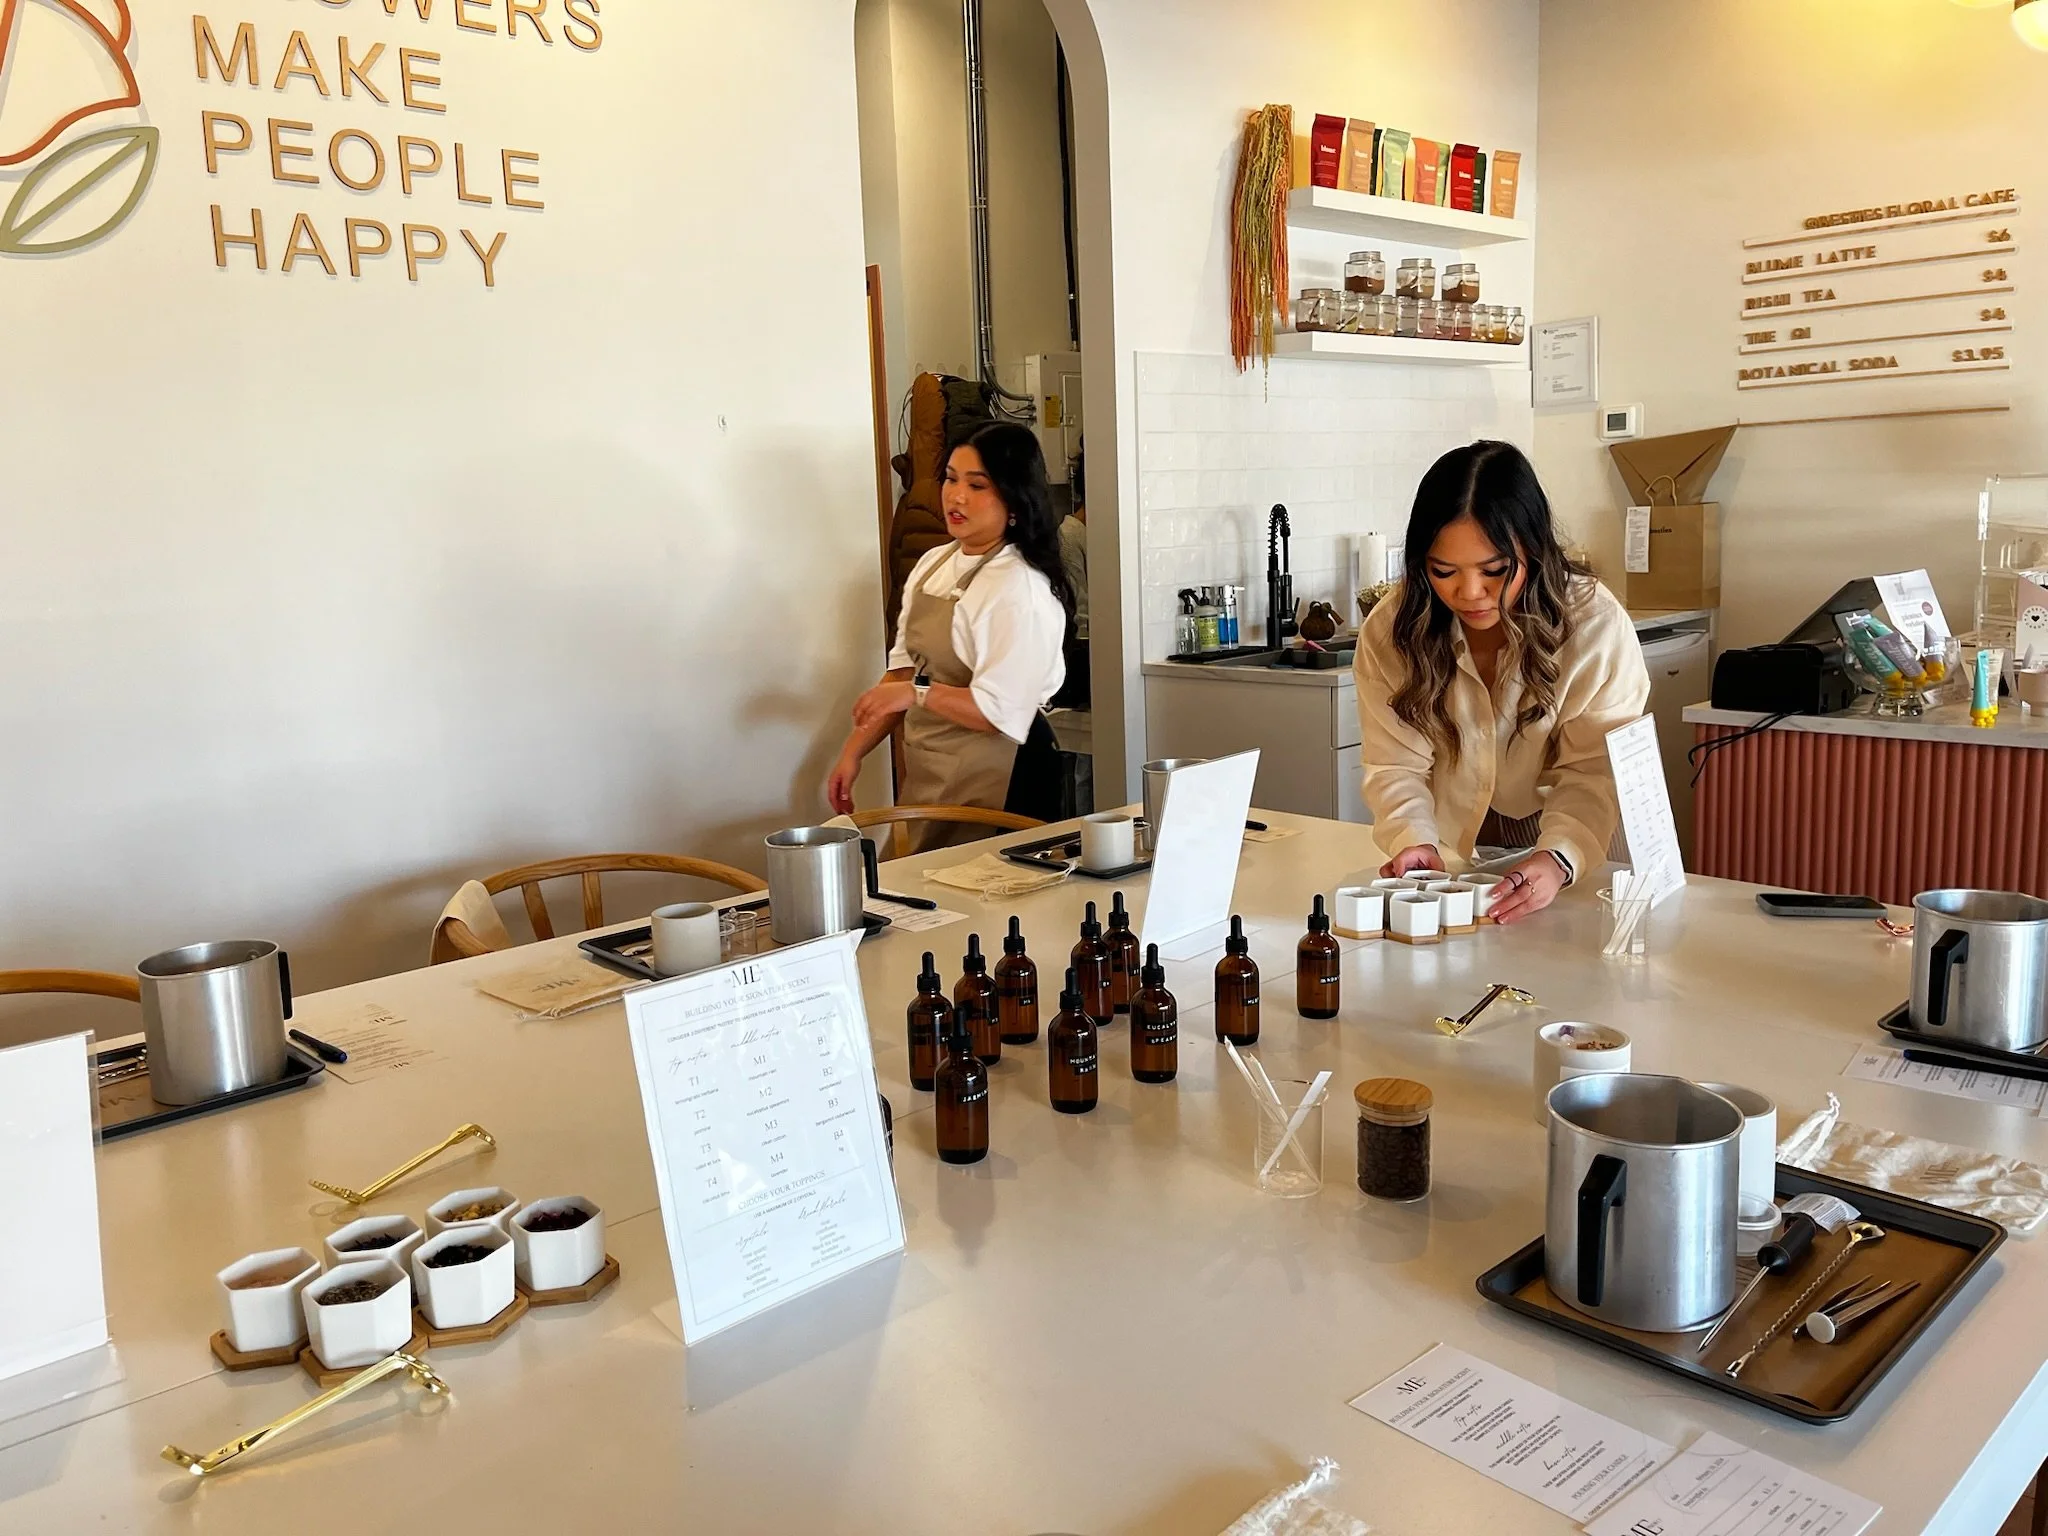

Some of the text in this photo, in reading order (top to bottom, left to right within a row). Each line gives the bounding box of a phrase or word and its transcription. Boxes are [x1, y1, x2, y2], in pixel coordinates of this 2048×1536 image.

[310, 0, 603, 51] ERS
[192, 14, 447, 113] MAKE
[202, 110, 545, 210] PEOPLE
[1886, 196, 1961, 218] FLORAL
[1964, 188, 2016, 208] CAFE
[1986, 228, 2011, 243] $6
[210, 204, 507, 288] HAPPY
[1745, 245, 1878, 275] BLUME LATTE
[1744, 288, 1837, 310] RISHI TEA
[1744, 330, 1777, 345] THE
[1738, 355, 1899, 381] BOTANICAL SODA
[685, 1001, 722, 1018] BUILDING
[745, 986, 787, 1003] SIGNATURE
[787, 976, 811, 990] SCENT
[753, 1054, 767, 1067] M1
[822, 1067, 834, 1077] B2
[689, 1075, 700, 1087] T1
[759, 1086, 773, 1098] M2
[828, 1097, 839, 1109] B3
[695, 1109, 706, 1120] T2
[764, 1119, 778, 1132] M3
[833, 1129, 844, 1141] B4
[700, 1142, 712, 1154] T3
[770, 1151, 785, 1165] M4
[706, 1176, 718, 1189] T4
[737, 1170, 826, 1210] CHOOSE YOUR TOPPINGS
[1396, 1376, 1427, 1395] ME
[1389, 1406, 1415, 1424] BUILDING
[1414, 1396, 1430, 1409] YOUR
[1455, 1367, 1471, 1380] SCENT
